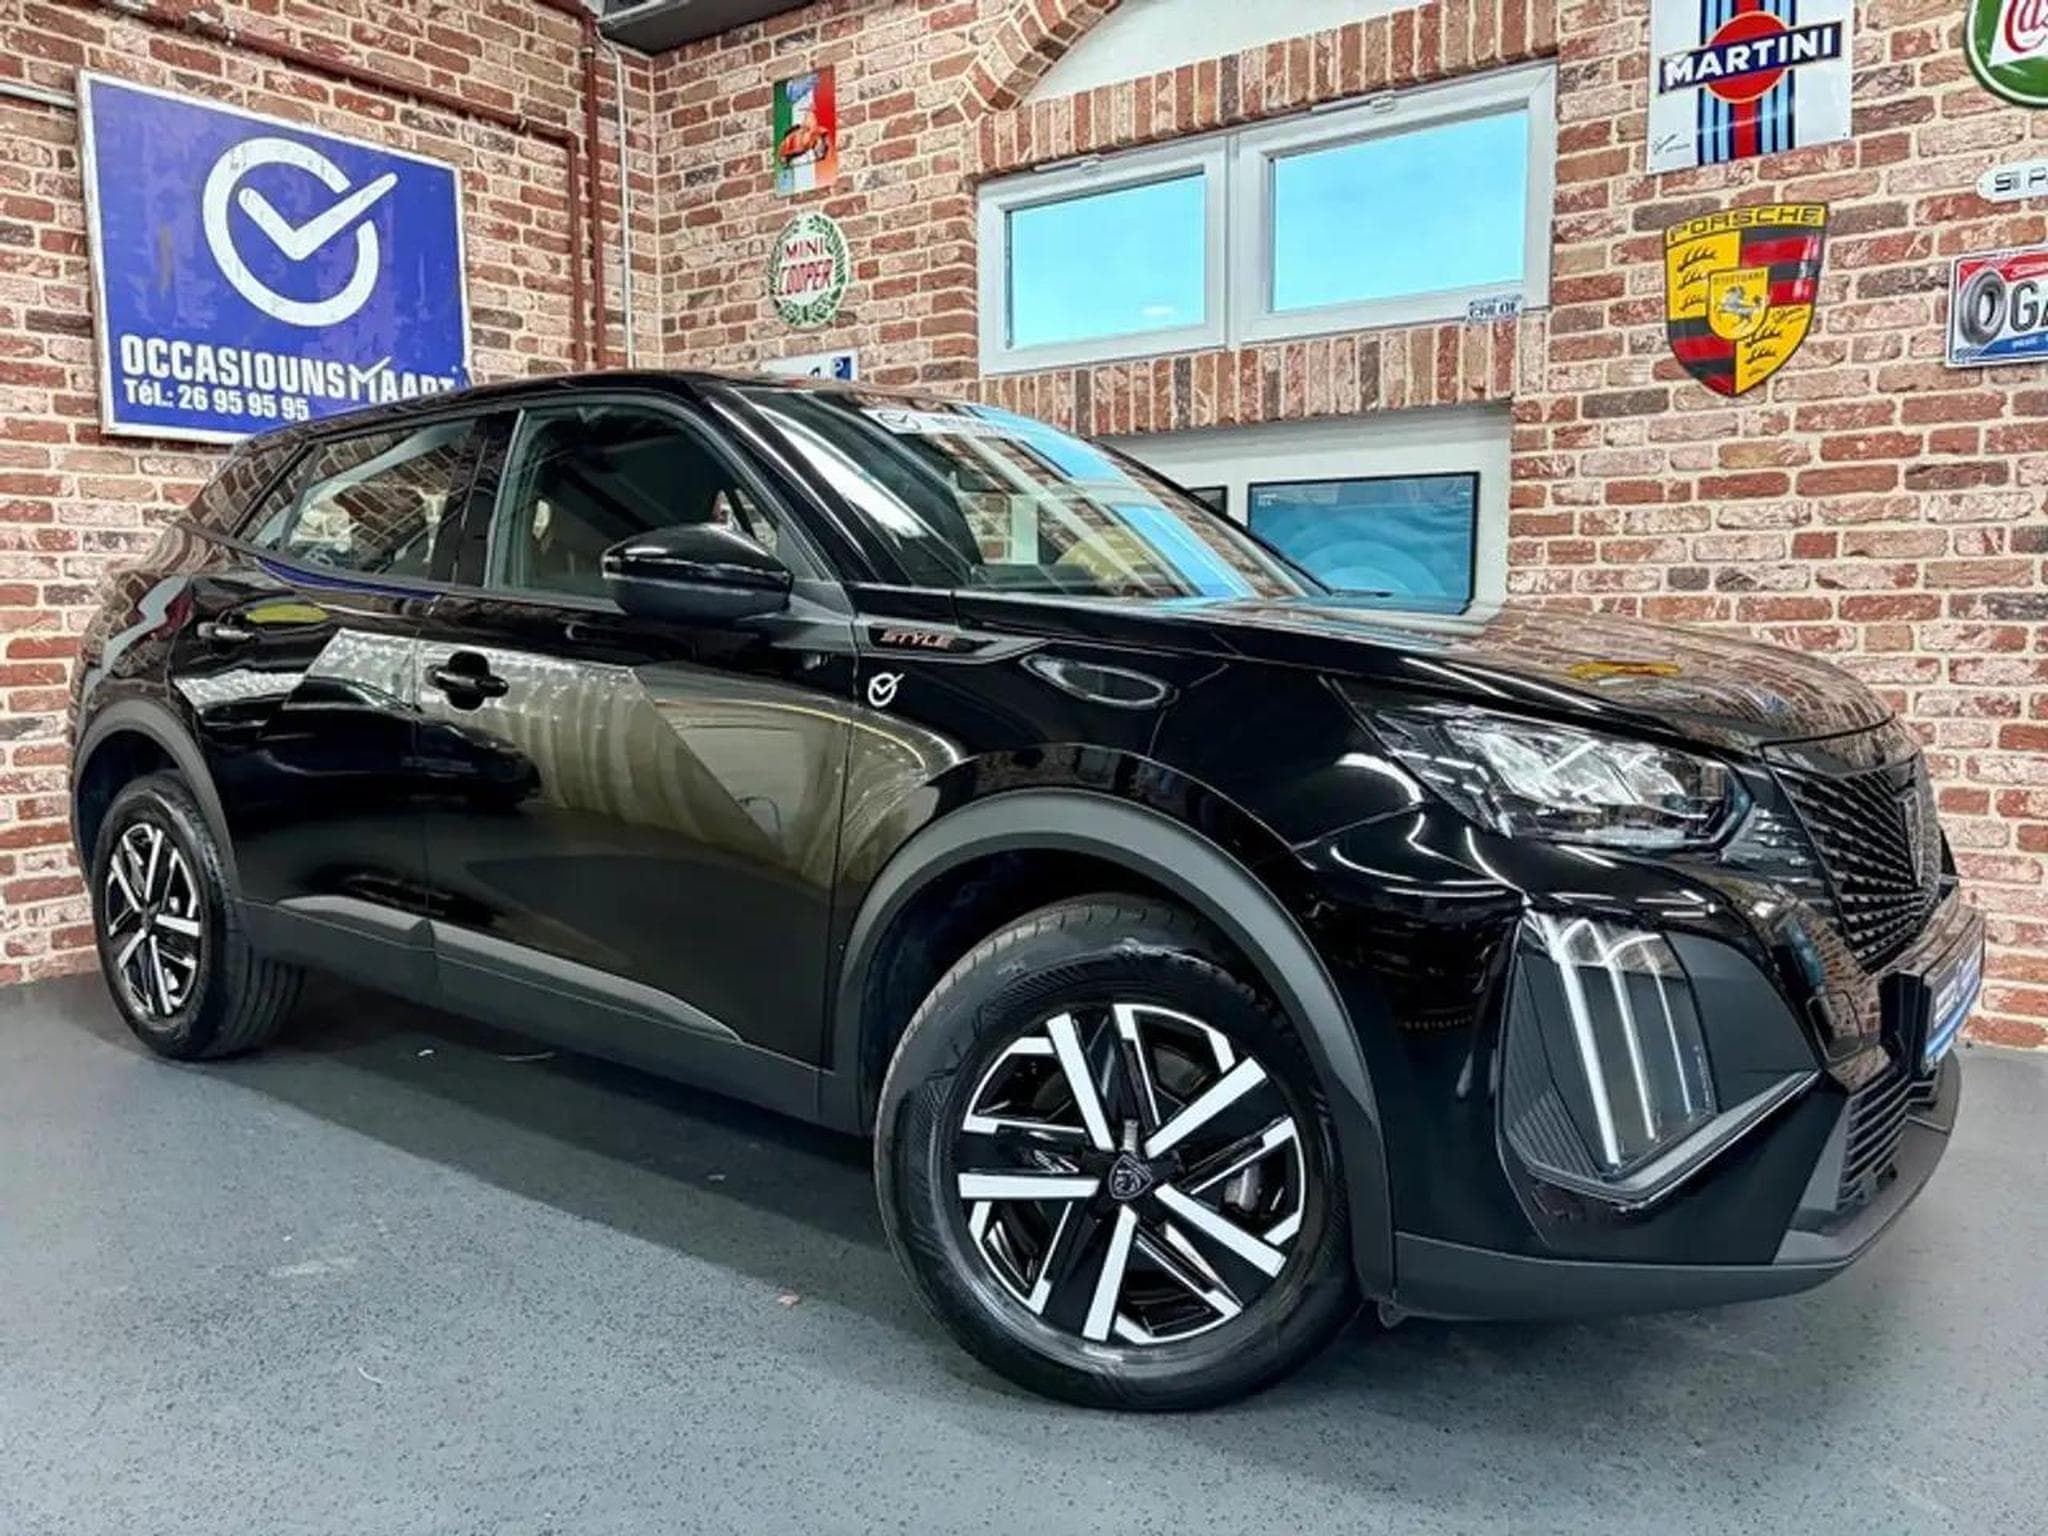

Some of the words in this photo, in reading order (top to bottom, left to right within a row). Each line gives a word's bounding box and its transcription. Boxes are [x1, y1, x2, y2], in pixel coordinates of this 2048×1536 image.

[1664, 27, 1834, 87] MARTINI
[1668, 206, 1822, 242] PORSCHE
[784, 236, 825, 258] MINI
[778, 257, 834, 297] COOPER
[177, 383, 210, 411] 26
[212, 387, 244, 416] 95
[248, 391, 278, 420] 95
[281, 396, 310, 422] 95
